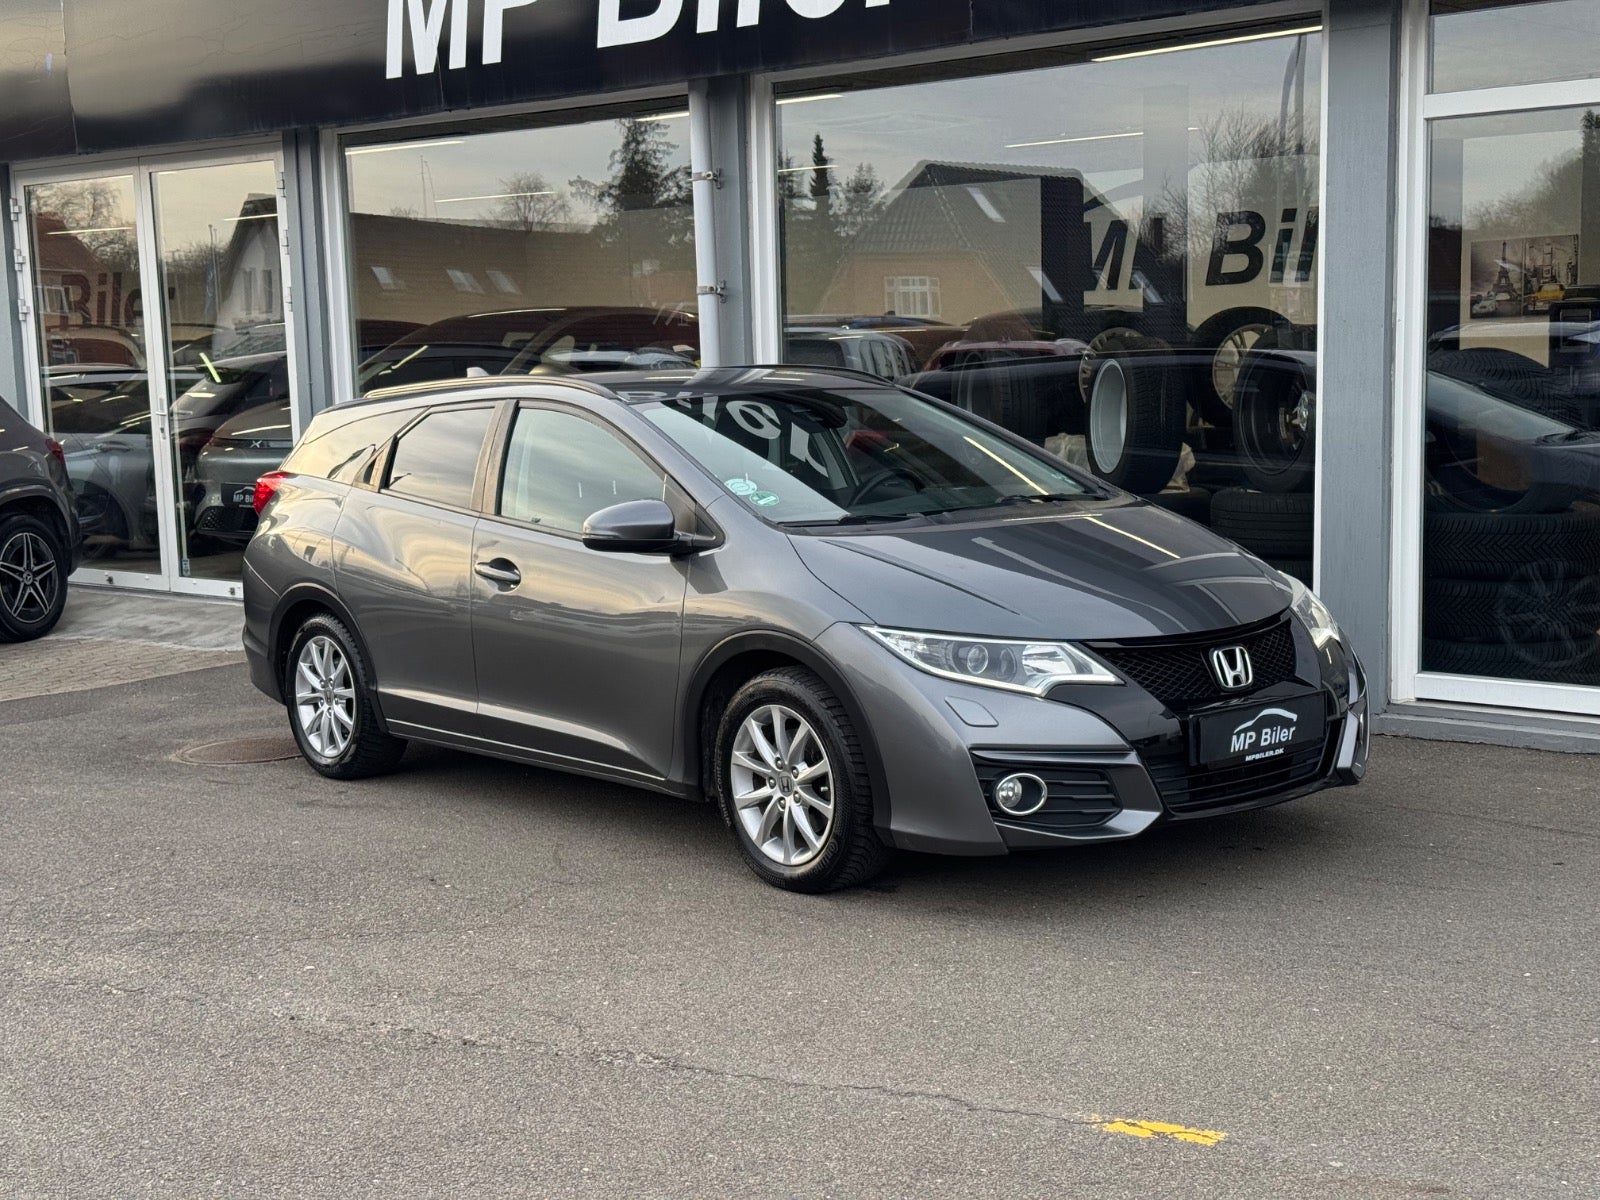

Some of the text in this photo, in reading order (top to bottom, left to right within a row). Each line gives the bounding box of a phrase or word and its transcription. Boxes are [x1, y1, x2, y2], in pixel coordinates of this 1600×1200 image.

[233, 494, 244, 503] MP
[1230, 725, 1296, 753] MP Biler
[1245, 747, 1285, 762] MPBILER.DK
